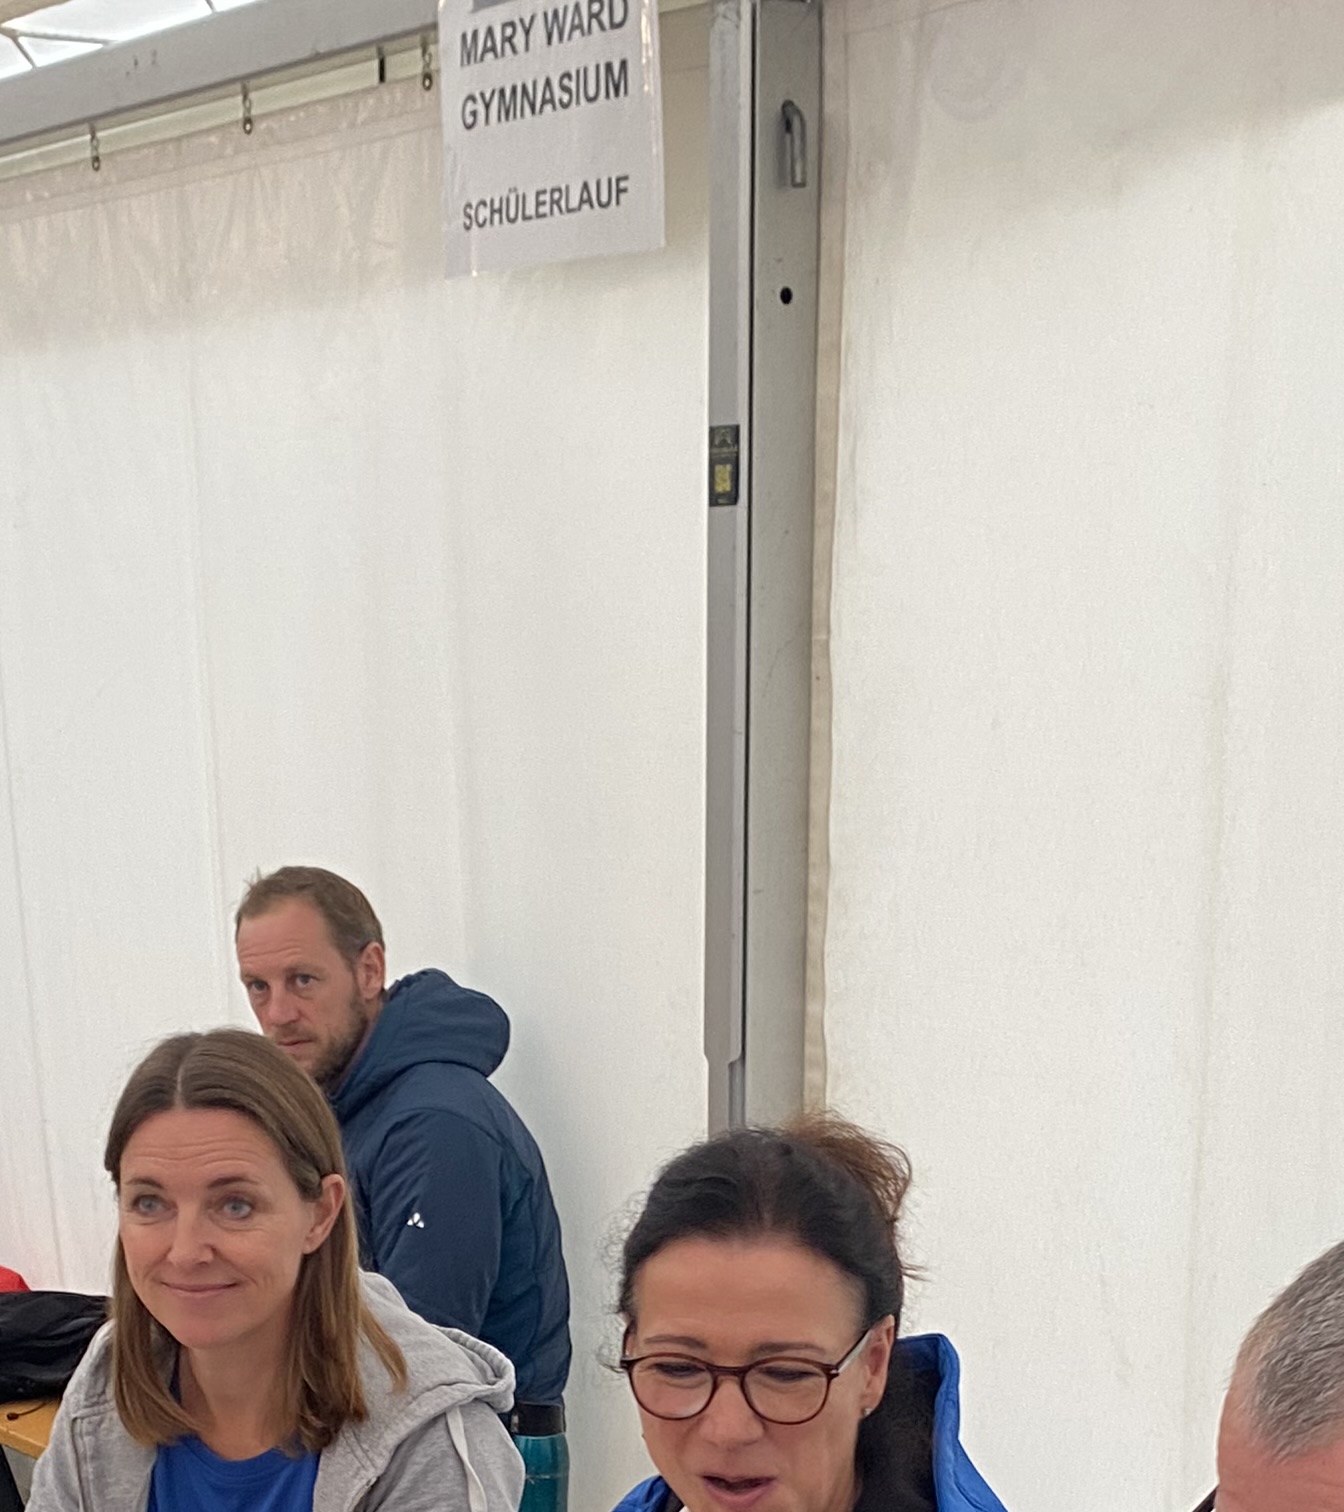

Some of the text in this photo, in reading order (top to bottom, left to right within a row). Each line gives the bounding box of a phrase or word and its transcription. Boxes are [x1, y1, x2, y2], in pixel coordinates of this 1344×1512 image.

[460, 0, 629, 66] MARY WARD
[460, 58, 630, 131] GYMNASIUM
[462, 174, 630, 232] SCHÜLERLAUF
